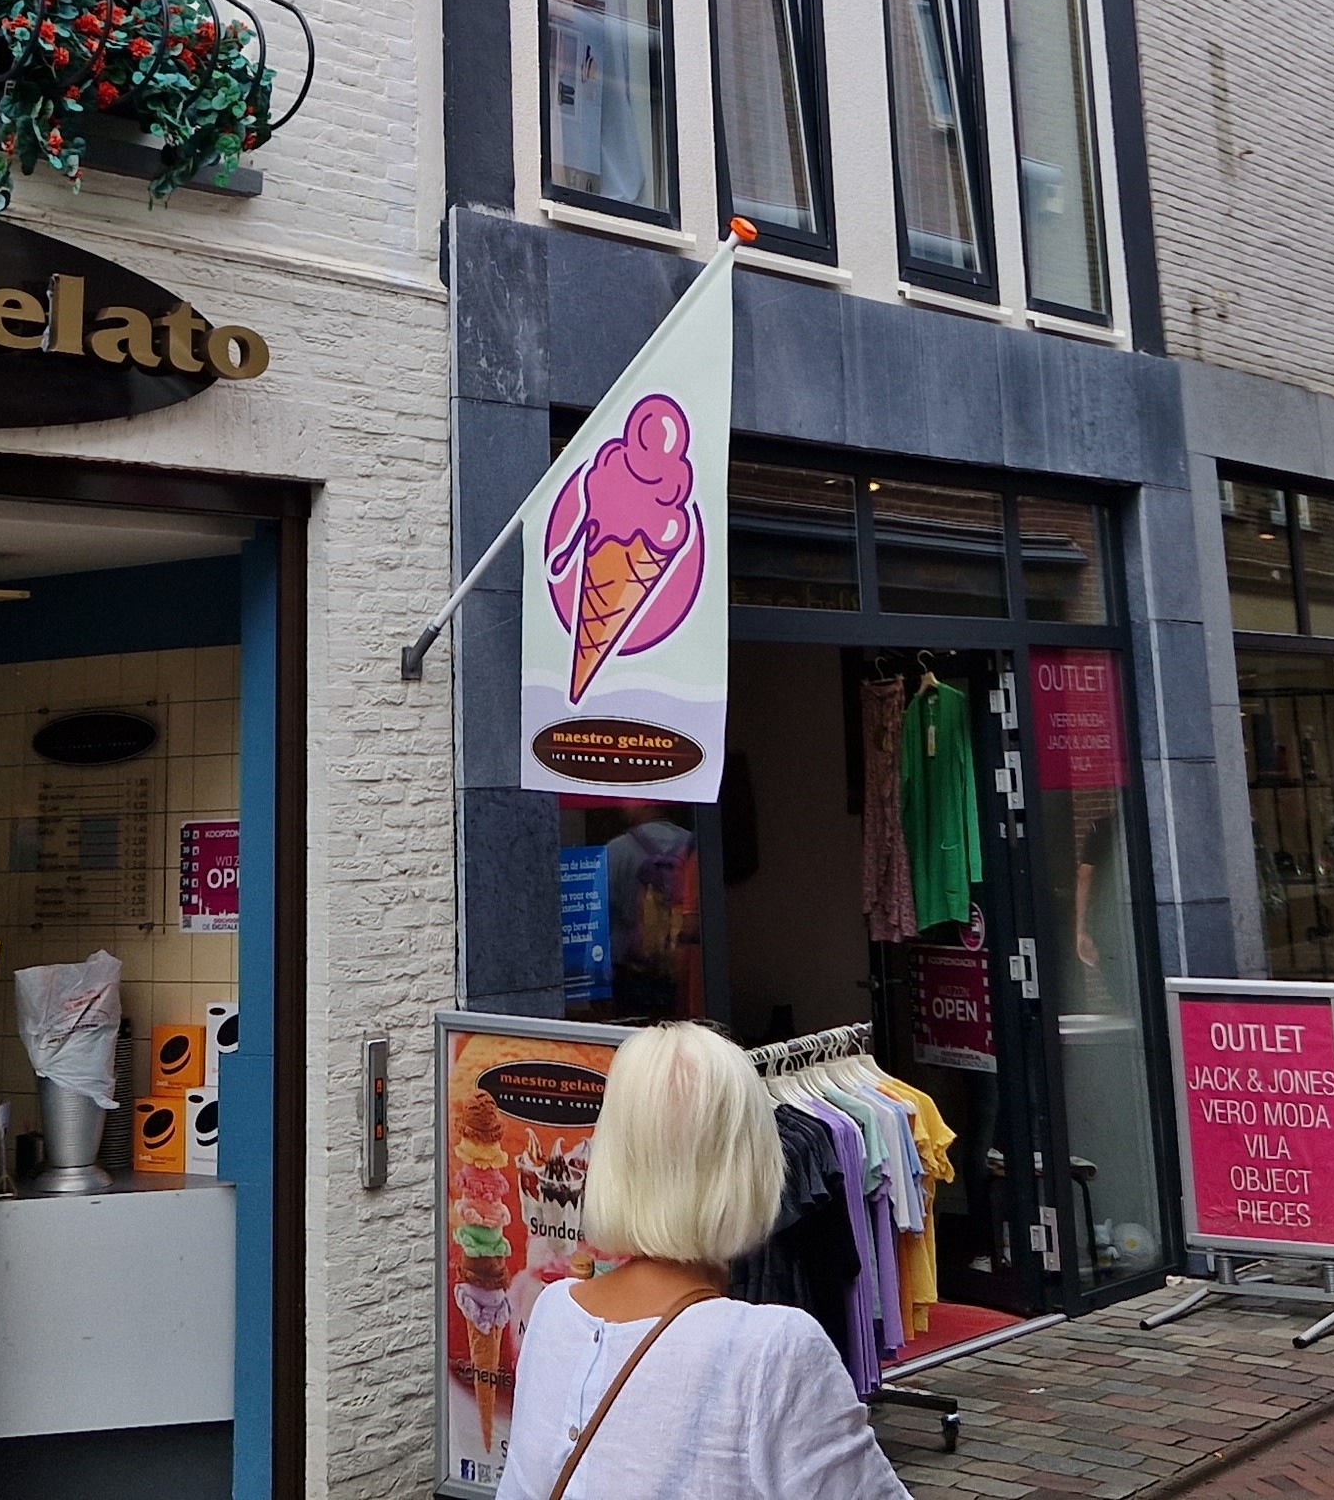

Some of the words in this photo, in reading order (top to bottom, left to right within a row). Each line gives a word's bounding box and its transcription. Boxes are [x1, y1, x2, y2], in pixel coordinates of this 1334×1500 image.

[1038, 664, 1105, 691] OUTLET
[1049, 713, 1076, 728] VERO
[1077, 713, 1105, 728] MODA
[552, 731, 614, 745] maestro
[617, 733, 674, 749] gelato
[1047, 735, 1072, 750] JACK
[1081, 734, 1111, 749] JONES
[932, 997, 979, 1023] OPEN
[1210, 1022, 1306, 1053] OUTLET
[499, 1072, 557, 1088] maestro
[559, 1077, 605, 1093] gelato
[1188, 1066, 1242, 1091] JACK
[1247, 1068, 1263, 1093] &
[1199, 1098, 1257, 1125] VERO
[1263, 1101, 1331, 1129] MODA
[1244, 1134, 1291, 1161] VILA
[1230, 1165, 1312, 1195] OBJECT
[1237, 1199, 1312, 1228] PIECES
